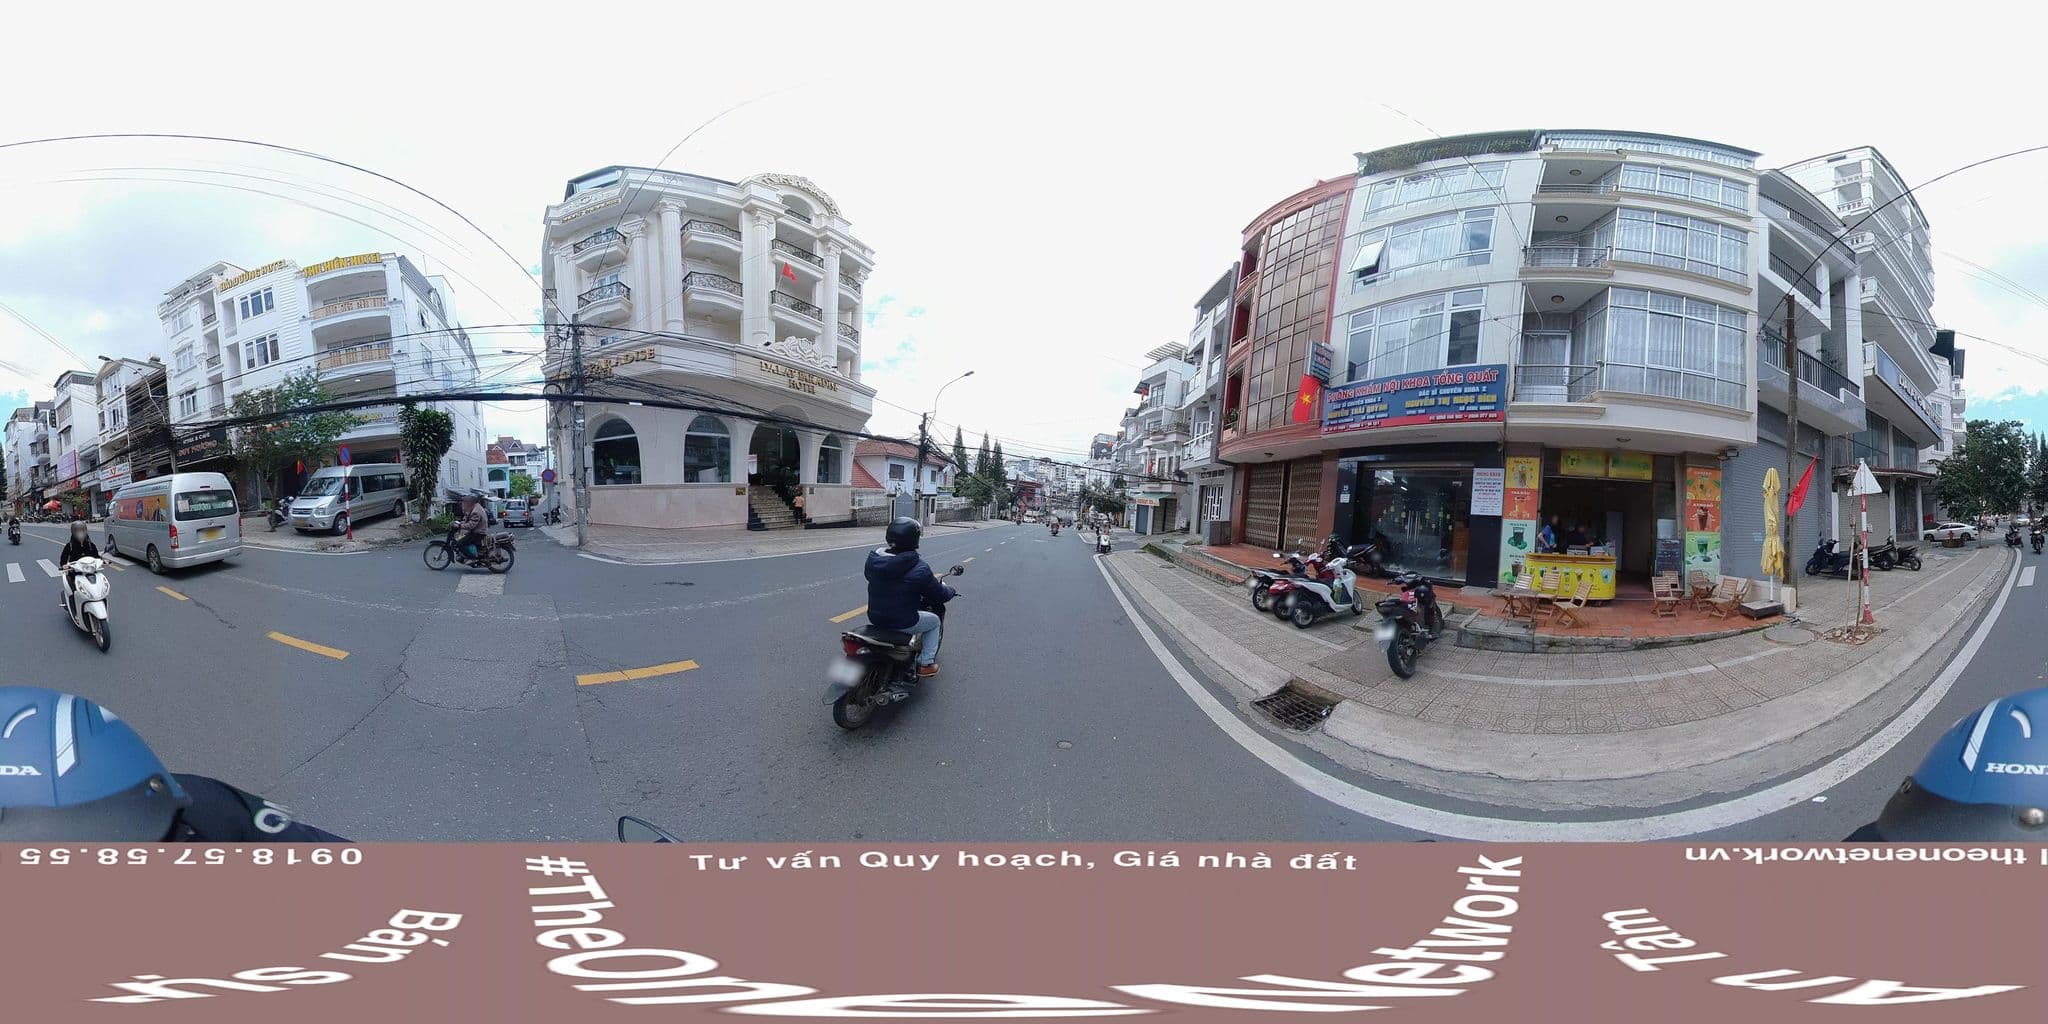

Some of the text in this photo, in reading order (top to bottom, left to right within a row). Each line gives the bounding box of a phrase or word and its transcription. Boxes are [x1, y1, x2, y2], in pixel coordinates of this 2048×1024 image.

[1327, 367, 1499, 403] PHÒNG KHÁM NỘI KHOA TỔNG QUÁT
